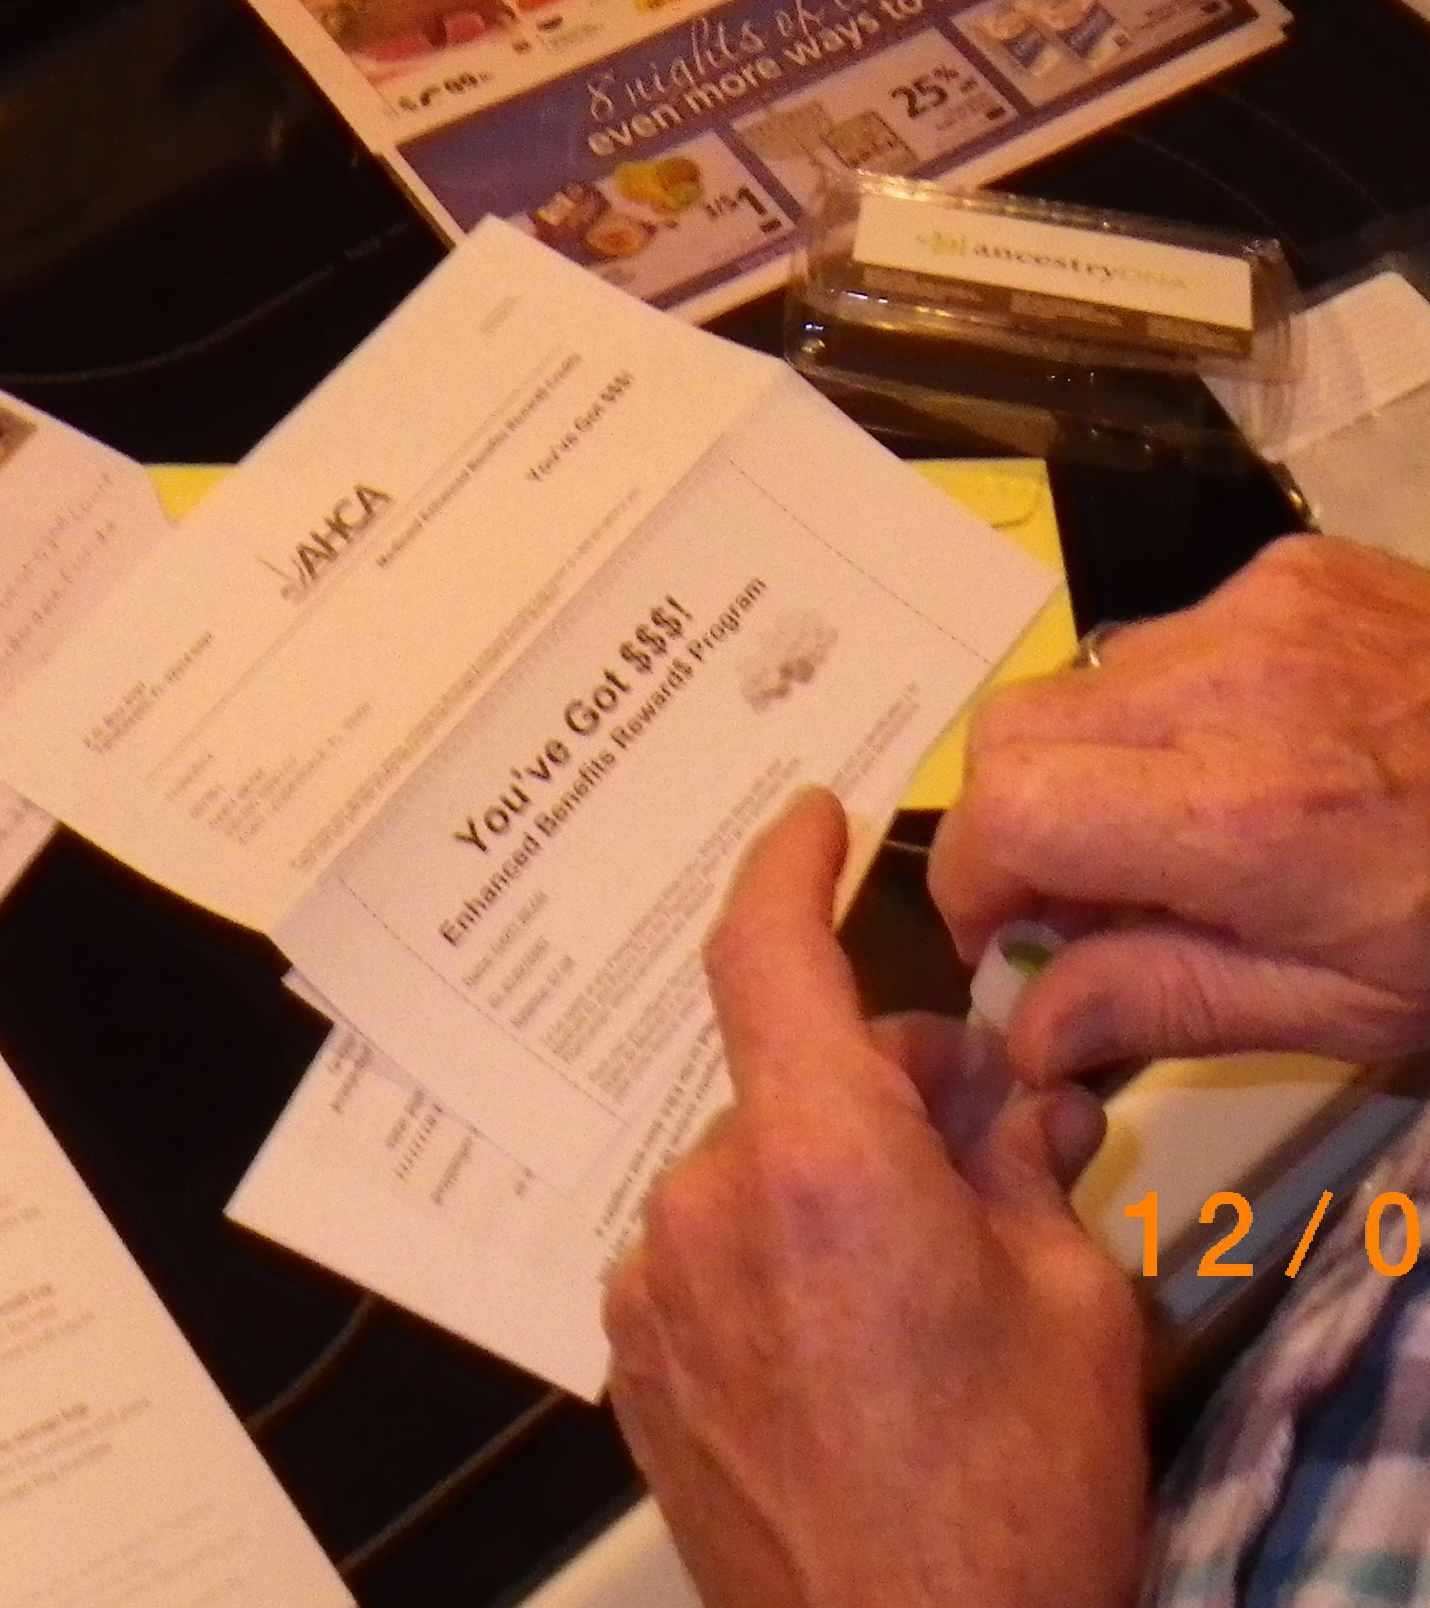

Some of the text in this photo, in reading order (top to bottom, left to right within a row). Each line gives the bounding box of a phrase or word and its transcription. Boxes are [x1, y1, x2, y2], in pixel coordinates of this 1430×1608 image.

[587, 95, 681, 157] even
[685, 57, 782, 116] more
[784, 8, 882, 68] ways
[891, 62, 962, 119] 25%
[570, 397, 608, 436] Got
[291, 473, 390, 579] AHCA
[439, 831, 541, 946] Enhanced
[534, 745, 618, 838] Benefits
[686, 572, 770, 664] Program
[456, 730, 573, 858] You've
[559, 663, 633, 741] Got
[617, 593, 695, 676] $$$!
